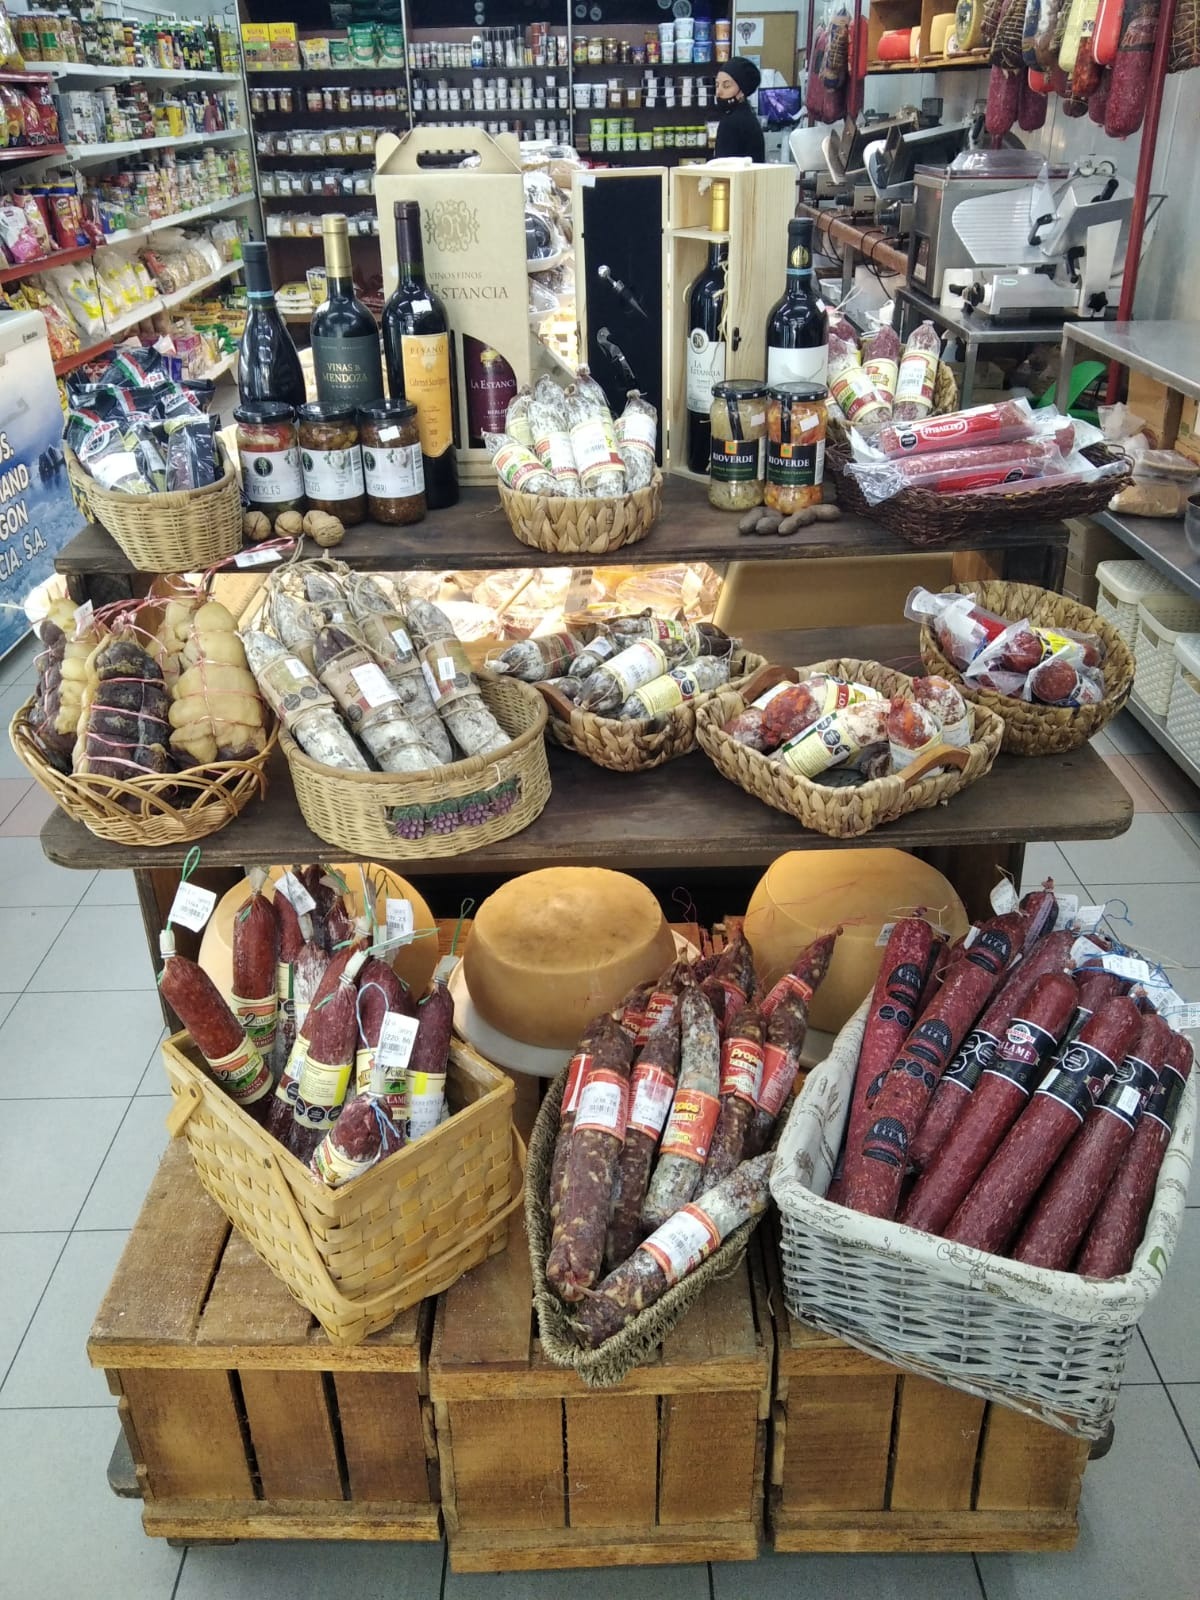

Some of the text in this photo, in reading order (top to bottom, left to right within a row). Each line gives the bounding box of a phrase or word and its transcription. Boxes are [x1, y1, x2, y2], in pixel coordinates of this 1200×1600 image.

[323, 373, 369, 383] MENDOZA
[480, 379, 516, 390] ESTANCI
[0, 463, 30, 503] AND
